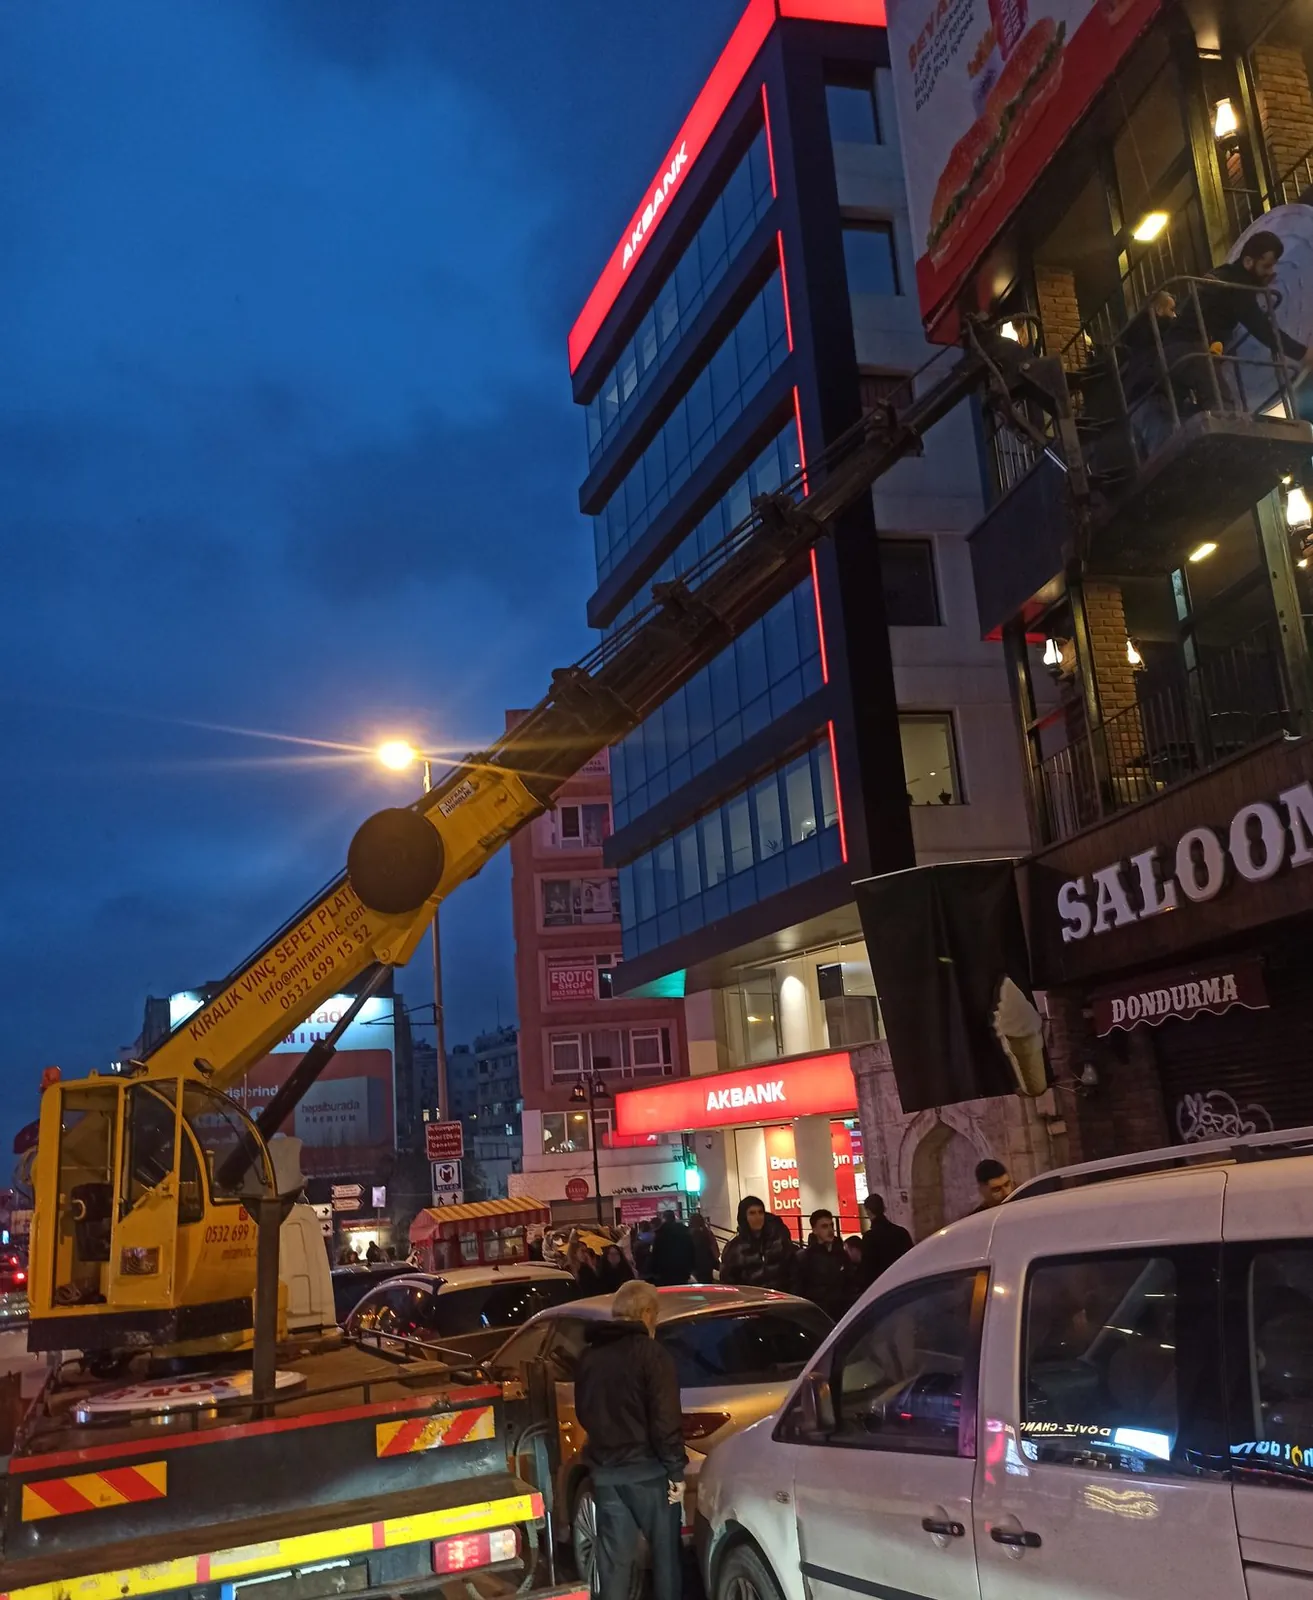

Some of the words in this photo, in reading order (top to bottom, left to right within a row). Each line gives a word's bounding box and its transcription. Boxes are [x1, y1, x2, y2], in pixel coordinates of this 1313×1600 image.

[622, 140, 688, 270] AKBANK
[274, 921, 318, 964] SEPET
[280, 978, 312, 1010] 0532
[312, 955, 335, 981] 699
[336, 940, 353, 960] 15
[353, 924, 372, 944] 52
[551, 970, 593, 984] EROTIC
[558, 981, 587, 990] SHOP
[1111, 974, 1239, 1023] DONDURMA
[706, 1080, 786, 1112] AKBANK
[205, 1225, 230, 1243] 0532
[231, 1224, 250, 1241] 699
